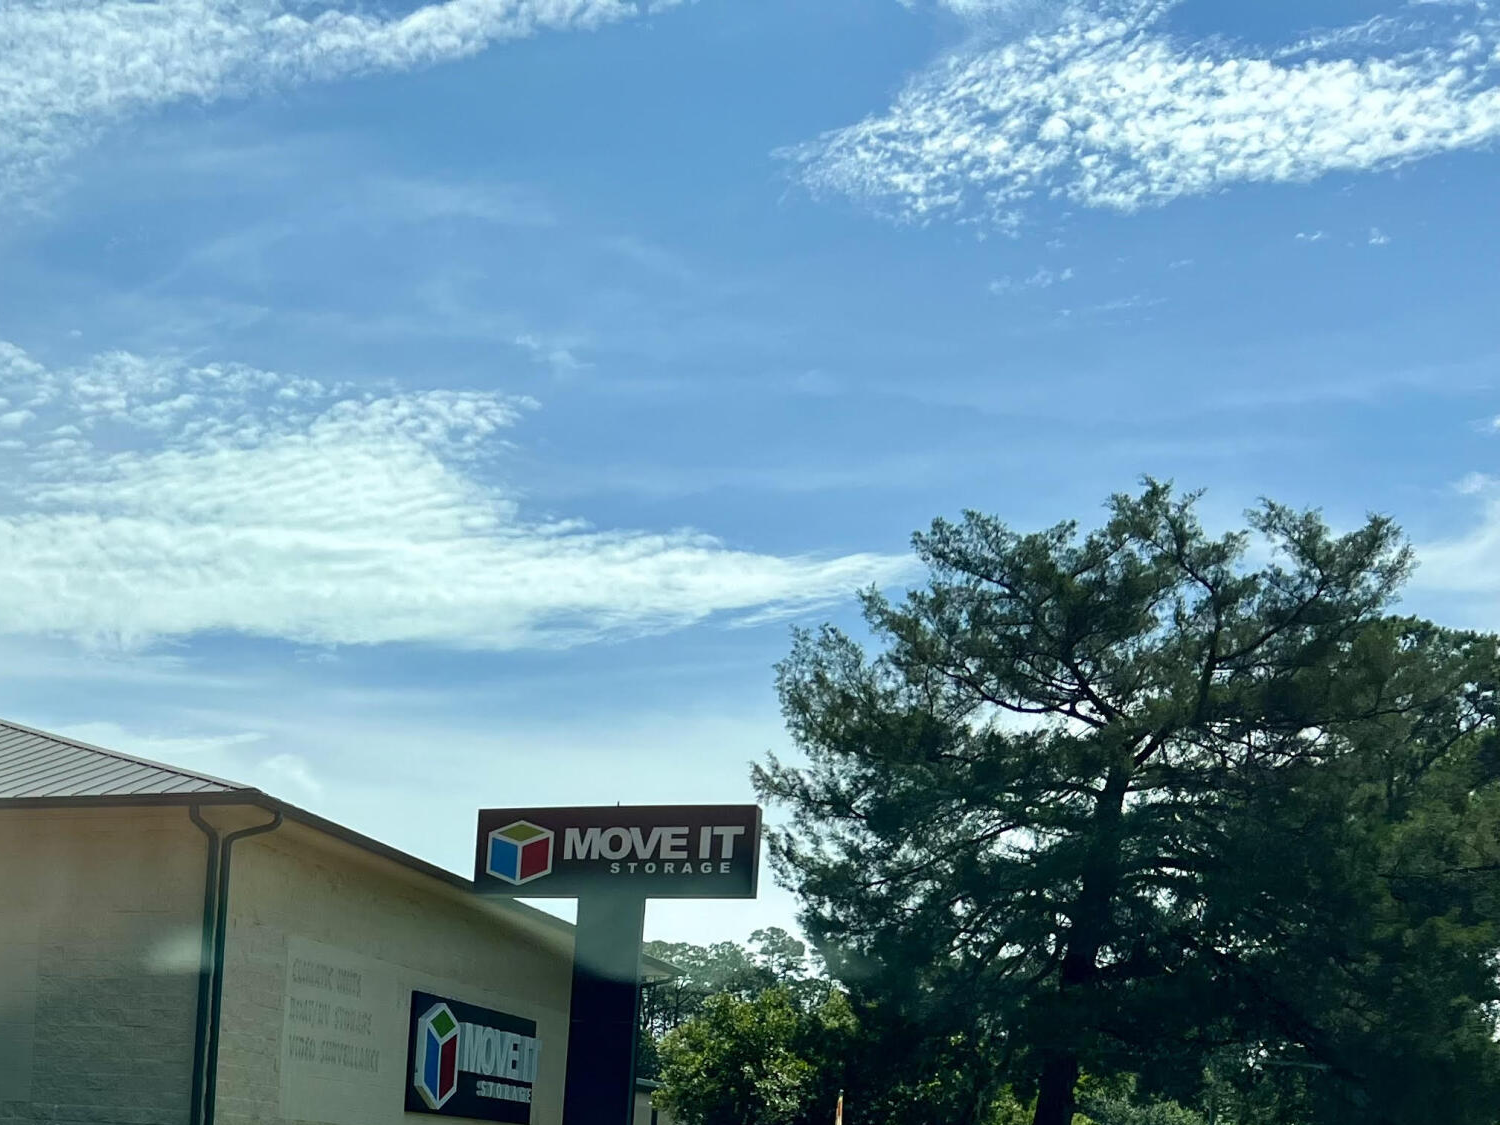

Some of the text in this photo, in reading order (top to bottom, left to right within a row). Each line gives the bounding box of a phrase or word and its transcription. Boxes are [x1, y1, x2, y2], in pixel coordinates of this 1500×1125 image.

[564, 826, 745, 860] MOVE IT
[611, 862, 731, 874] STORAGE
[460, 1022, 521, 1080] MOVE
[476, 1081, 532, 1103] STORAGE
